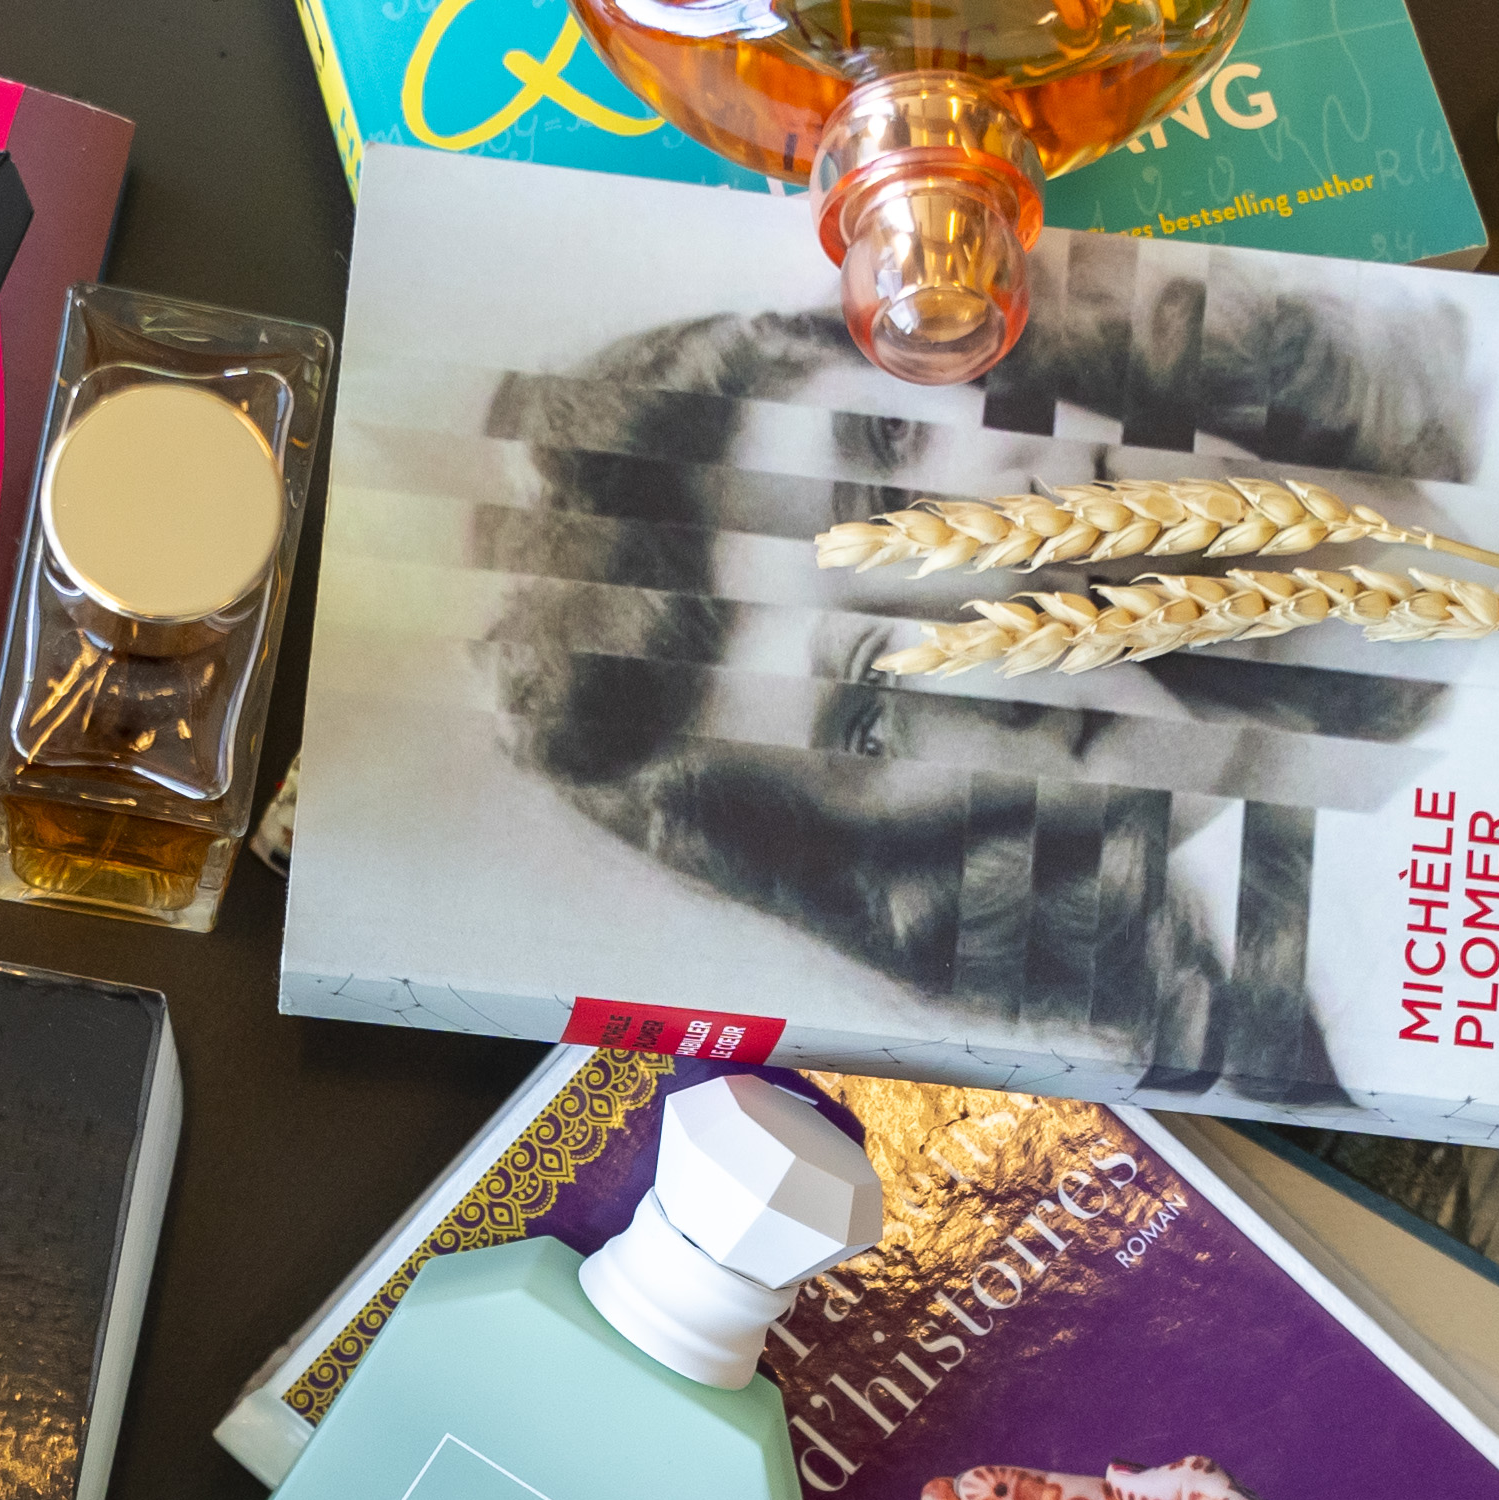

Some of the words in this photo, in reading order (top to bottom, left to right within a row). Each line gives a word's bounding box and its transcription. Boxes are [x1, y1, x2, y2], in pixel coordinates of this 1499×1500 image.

[1158, 192, 1293, 235] bestselling
[1296, 173, 1374, 204] author
[1398, 787, 1457, 1044] MICHÈLE
[675, 1020, 713, 1057] HABILLER
[709, 1047, 735, 1060] LE
[1115, 1192, 1188, 1269] ROMAN
[789, 1137, 1139, 1493] d'histoires
